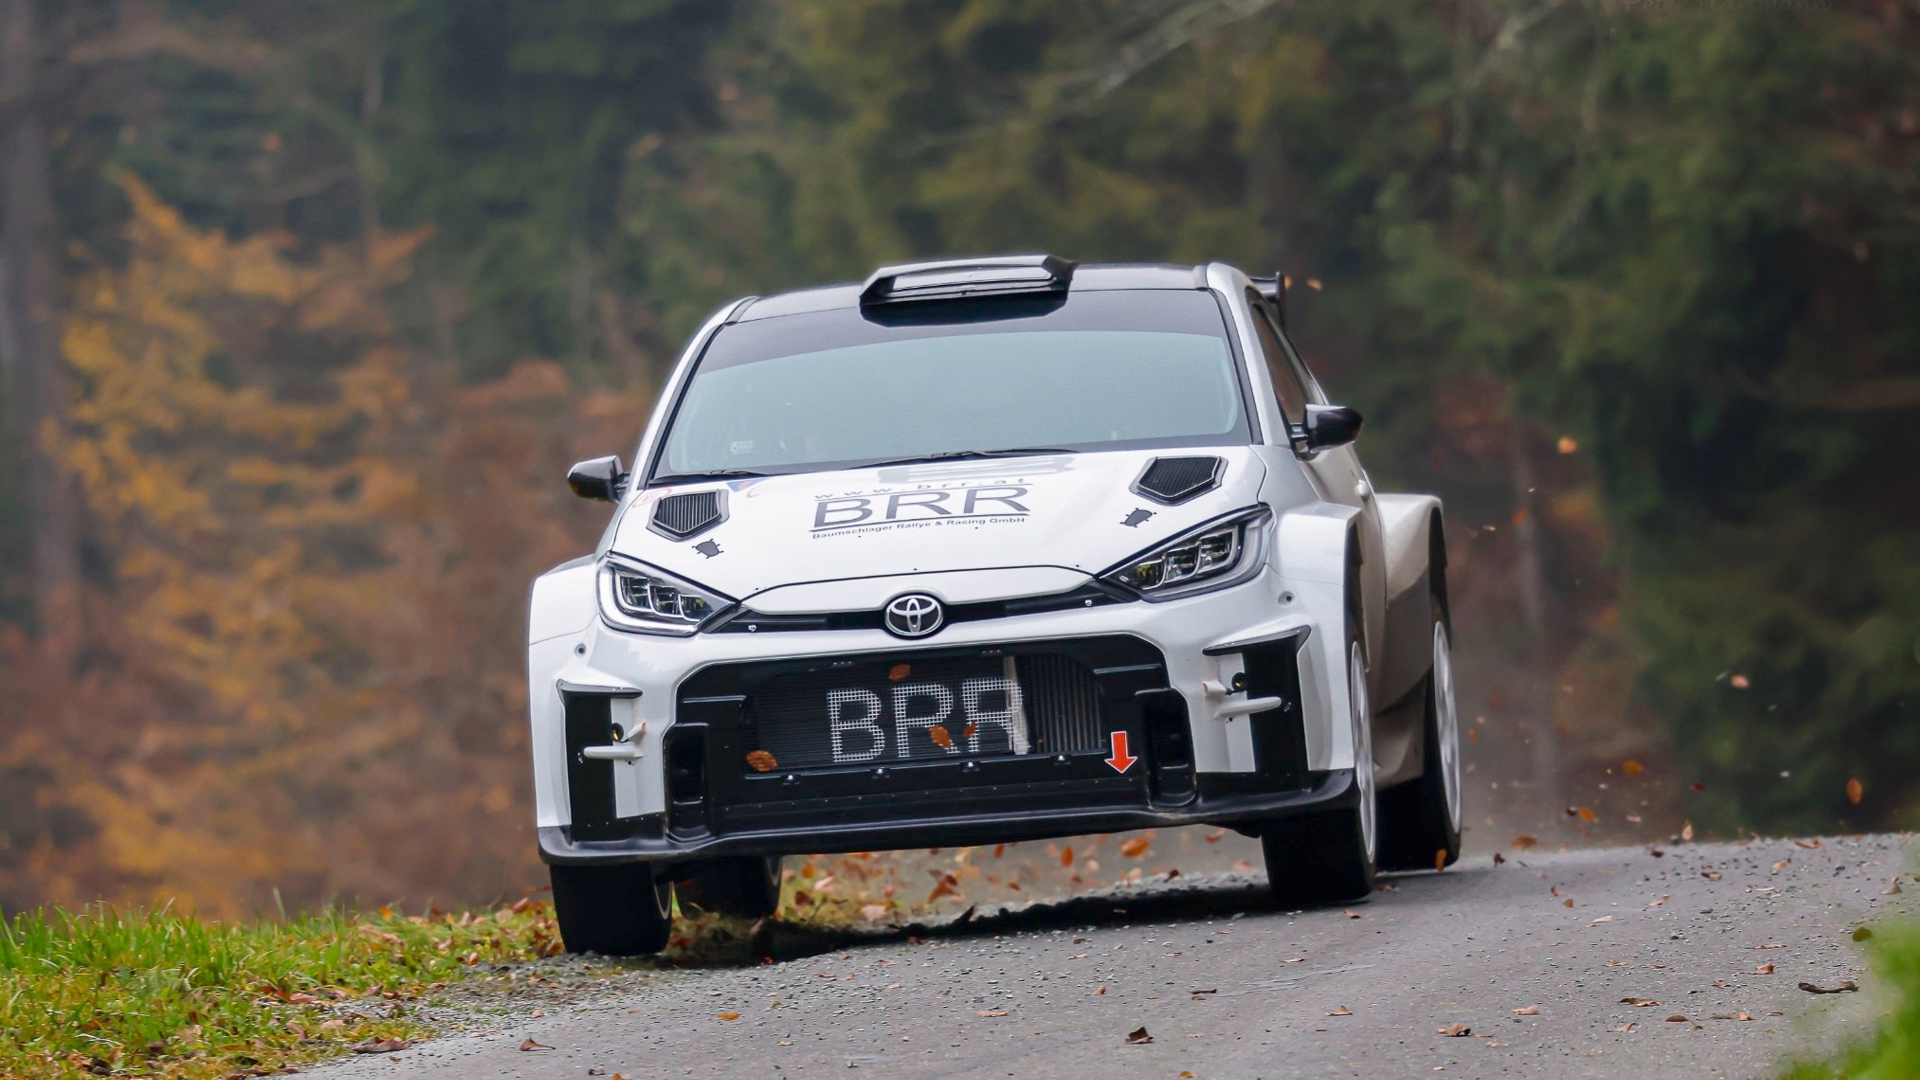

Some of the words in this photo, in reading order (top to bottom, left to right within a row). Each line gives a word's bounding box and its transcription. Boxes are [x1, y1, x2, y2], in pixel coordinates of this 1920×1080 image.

[813, 487, 1031, 527] BRR
[812, 524, 892, 539] Baumschlager
[897, 521, 931, 530] Rallye
[946, 518, 985, 526] Racing
[827, 678, 1031, 762] BRR
